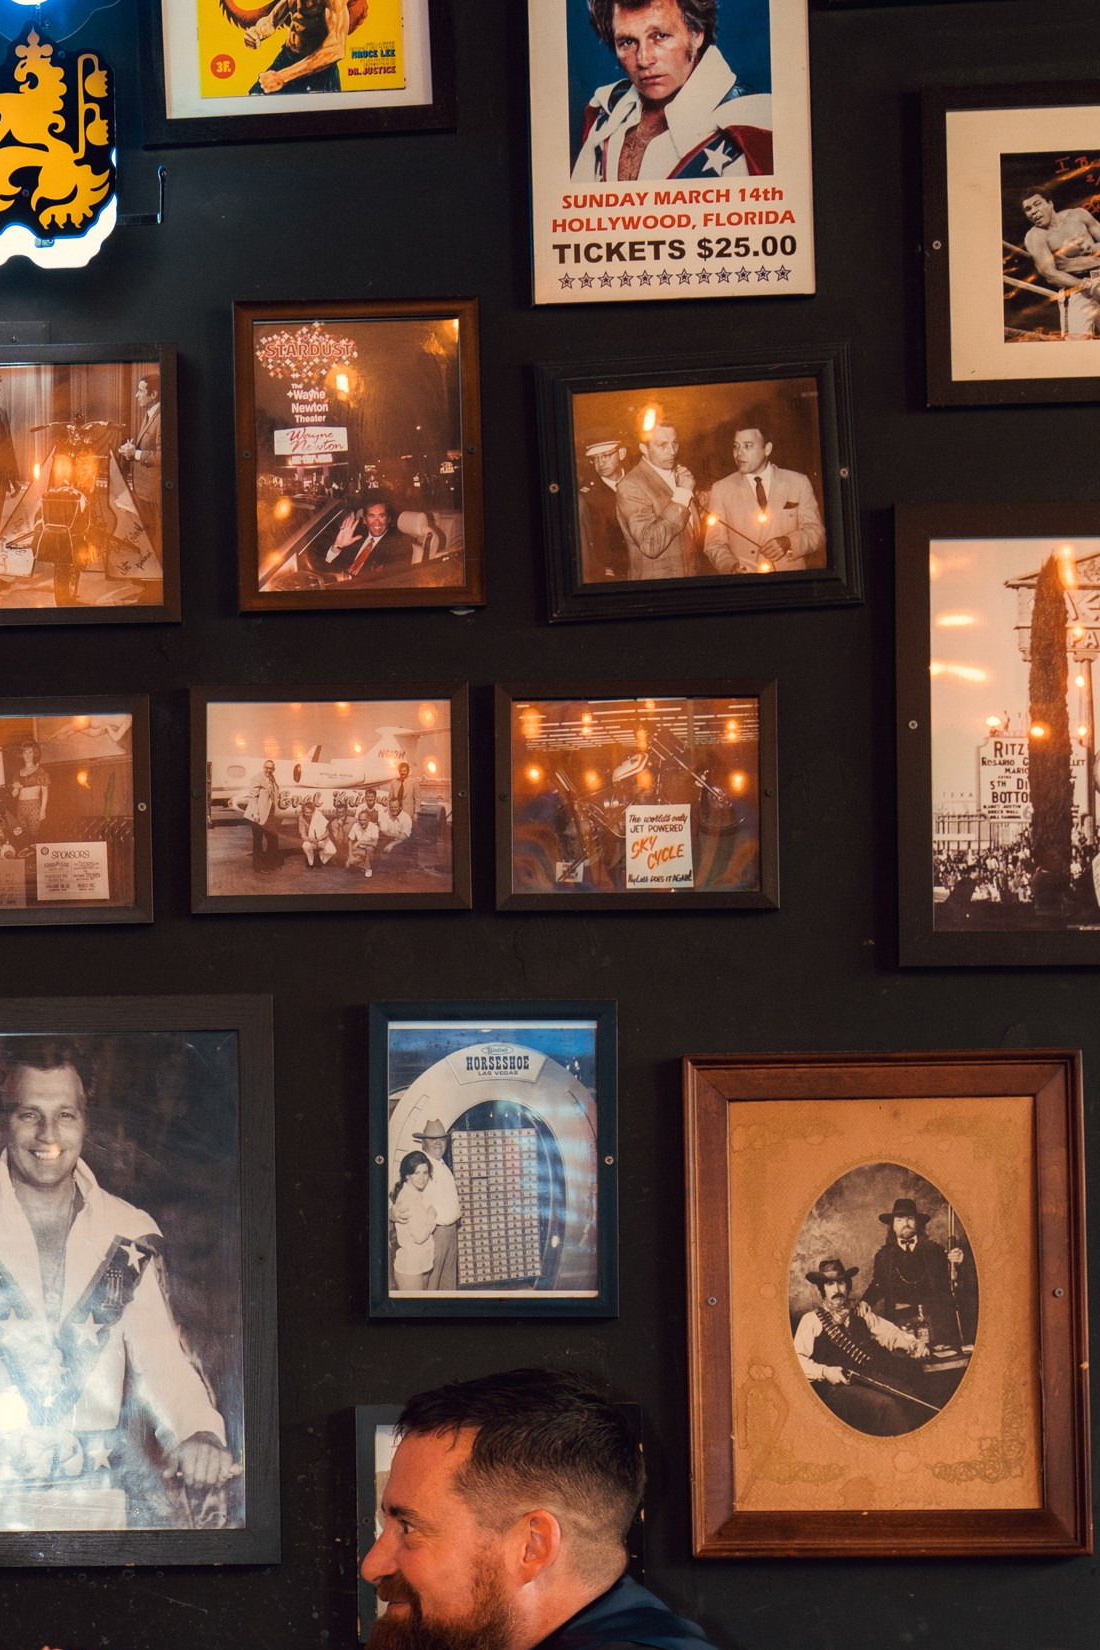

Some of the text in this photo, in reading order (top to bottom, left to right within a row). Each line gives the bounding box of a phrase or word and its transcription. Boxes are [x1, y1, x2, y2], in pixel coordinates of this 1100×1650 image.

[380, 49, 396, 57] LEE
[348, 66, 396, 76] DR. JUSTICE
[562, 187, 784, 209] SUNDAY MARCH 14th
[552, 210, 796, 233] HOLLYWOOD, FLORIDA
[552, 235, 797, 264] TICKETS $25.00
[266, 342, 353, 358] STARDUST
[293, 389, 326, 401] Wayne
[291, 402, 328, 413] Newton
[295, 414, 326, 423] Theater
[287, 429, 334, 443] Wayne
[994, 741, 1025, 758] RITZ
[982, 757, 1015, 767] ROSARIO
[629, 814, 642, 823] The
[671, 813, 688, 824] only
[630, 824, 684, 833] JET POWERED
[631, 835, 658, 860] SKY
[51, 850, 90, 860] SPONSORS
[647, 844, 685, 870] CYCLE
[466, 1055, 530, 1071] HORSESHOE
